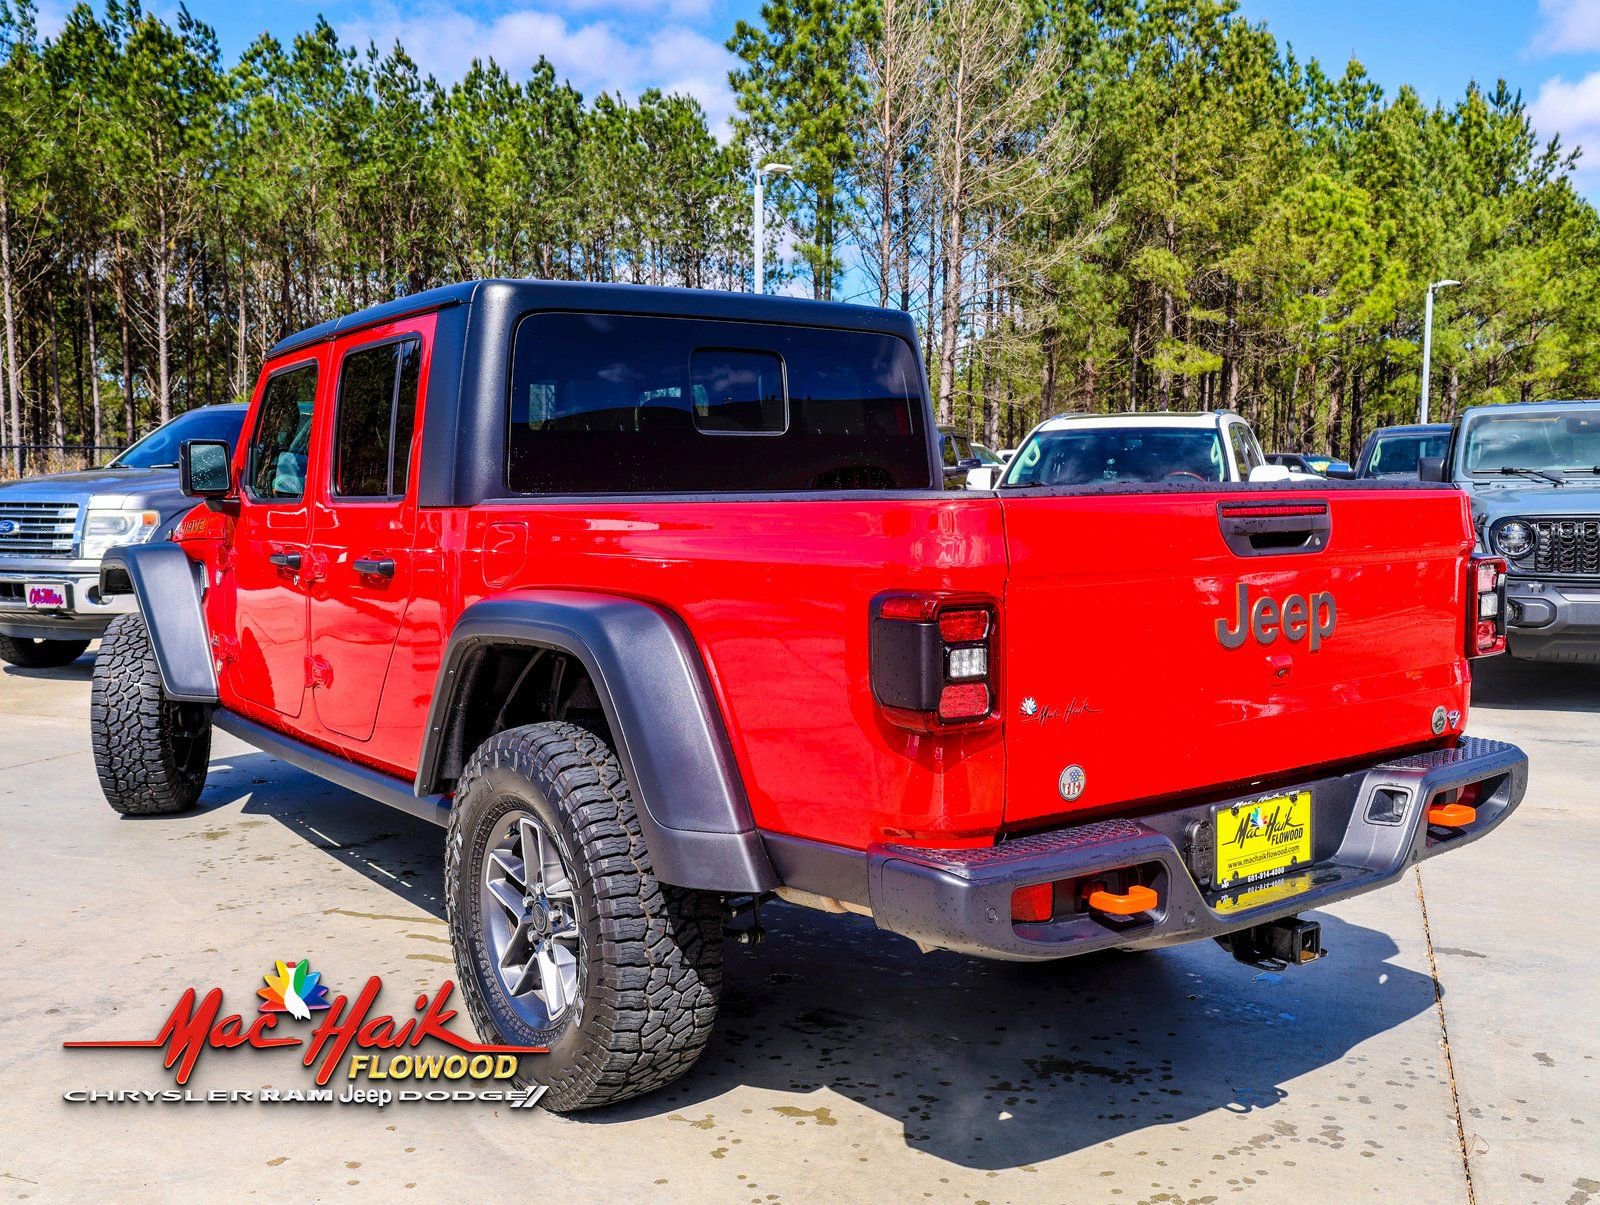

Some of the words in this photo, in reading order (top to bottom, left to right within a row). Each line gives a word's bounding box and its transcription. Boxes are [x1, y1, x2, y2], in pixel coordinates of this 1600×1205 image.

[1215, 582, 1337, 653] Jeep
[1222, 812, 1264, 849] Mac
[1263, 805, 1304, 842] Haik
[1271, 827, 1304, 846] FLOWOOD
[1228, 845, 1300, 869] www.machaikflowood.com
